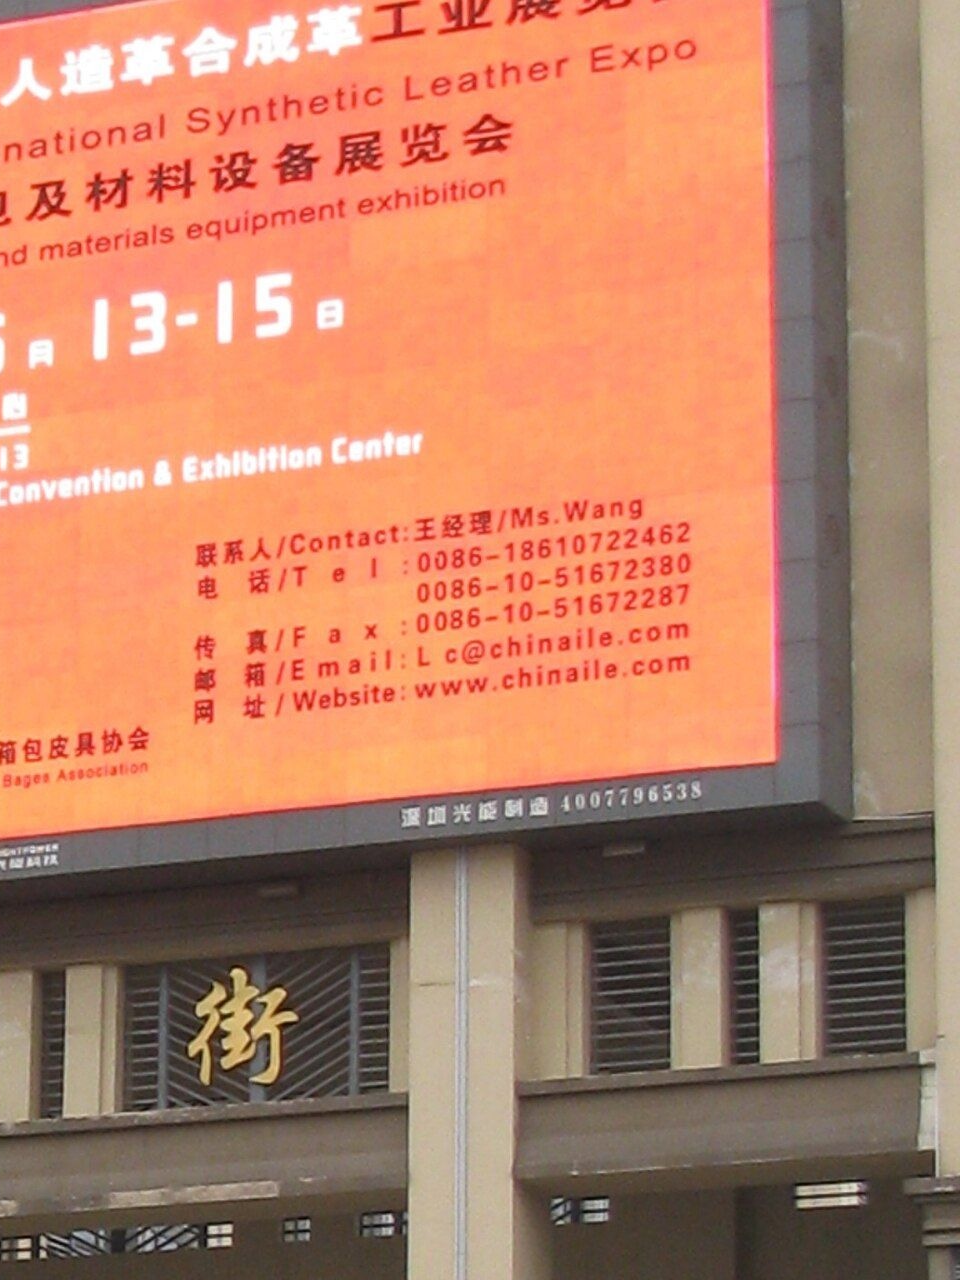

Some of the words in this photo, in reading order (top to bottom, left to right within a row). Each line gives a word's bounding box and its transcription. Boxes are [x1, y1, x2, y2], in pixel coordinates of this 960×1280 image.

[185, 82, 384, 136] Synthetic
[404, 57, 570, 101] Leather
[590, 39, 698, 73] Expo
[39, 224, 175, 261] materials
[186, 198, 346, 242] equipment
[357, 175, 506, 216] exhibition
[153, 458, 173, 487] &
[183, 443, 322, 484] Exhibition
[331, 430, 424, 466] Center
[417, 521, 691, 573] 0086-18610722462
[416, 552, 692, 604] 0086-10-51672380
[416, 583, 691, 634] 0086-10-51672287
[56, 760, 149, 783] Association
[560, 779, 702, 813] 4007796538
[187, 967, 300, 1087] 街
